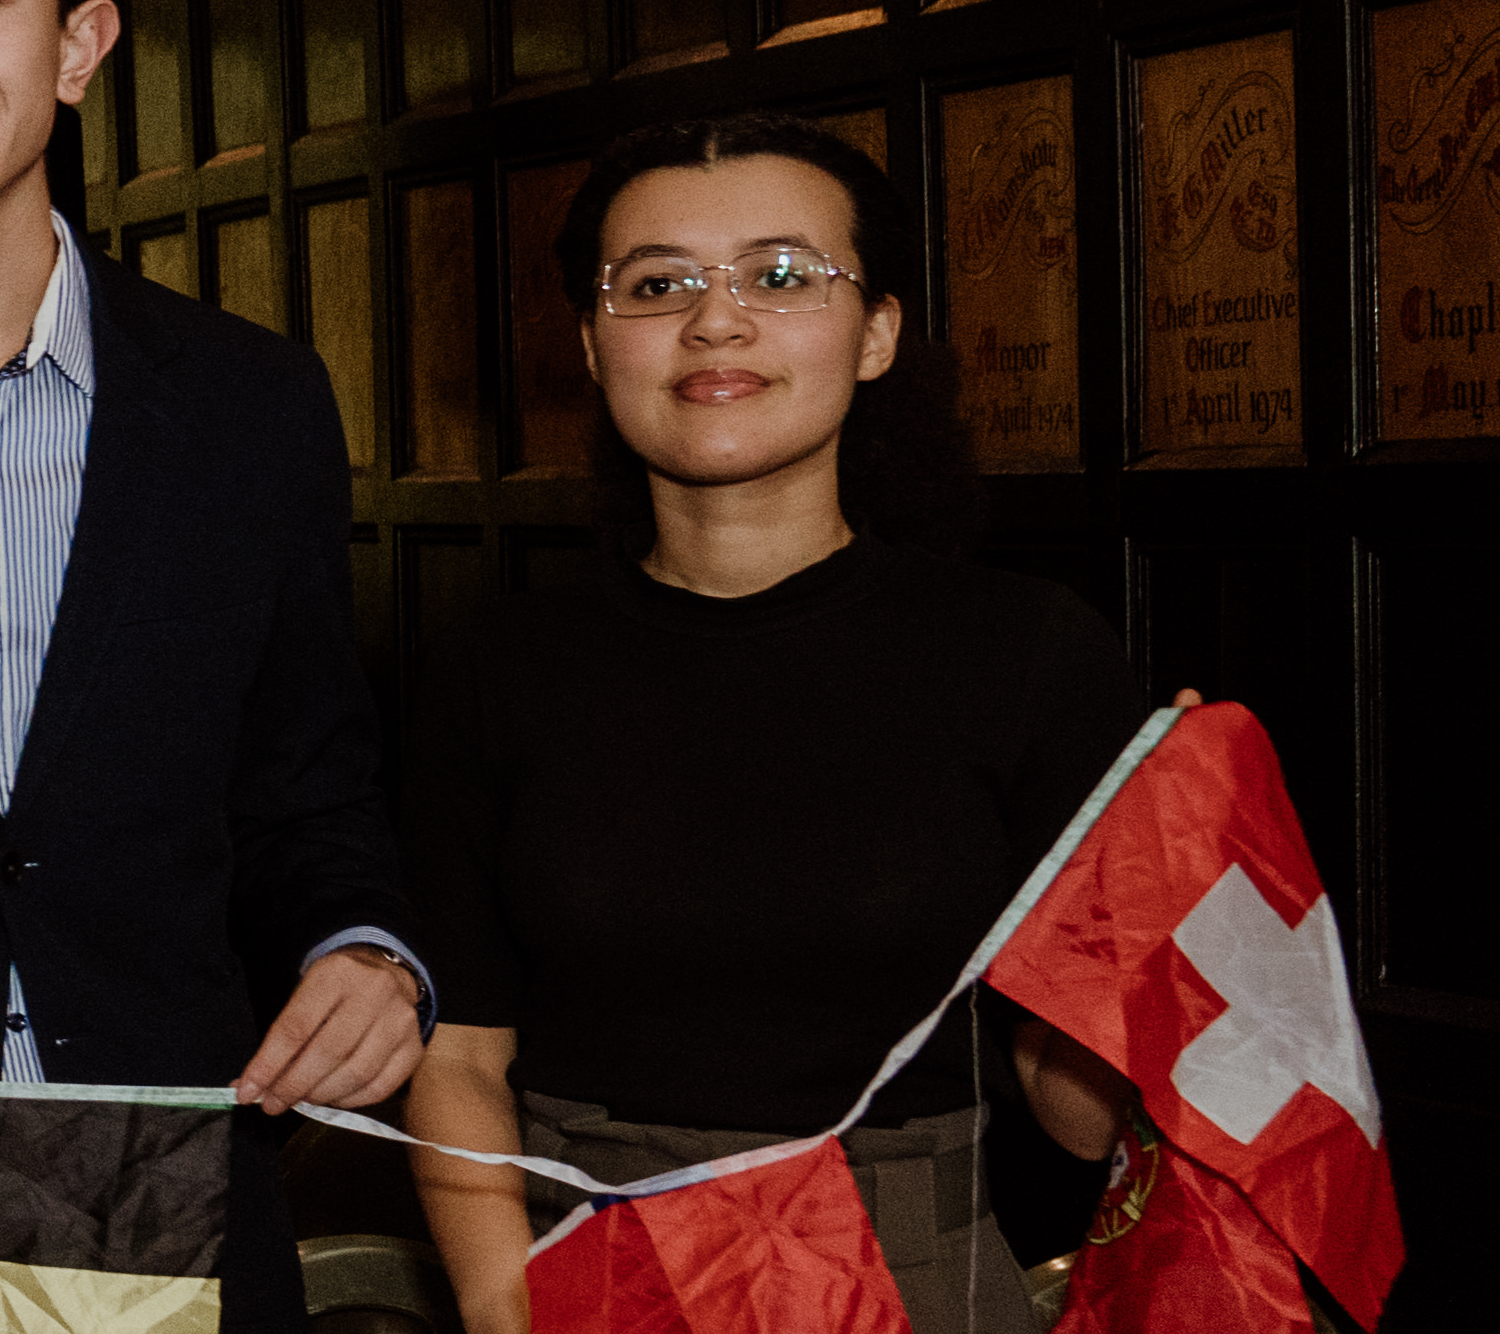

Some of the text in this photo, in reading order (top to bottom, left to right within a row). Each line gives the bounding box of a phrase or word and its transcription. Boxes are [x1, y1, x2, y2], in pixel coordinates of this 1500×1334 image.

[1152, 287, 1296, 332] Chief Executive
[1185, 336, 1252, 373] Officer
[1181, 382, 1241, 436] April
[1249, 388, 1293, 434] 1974
